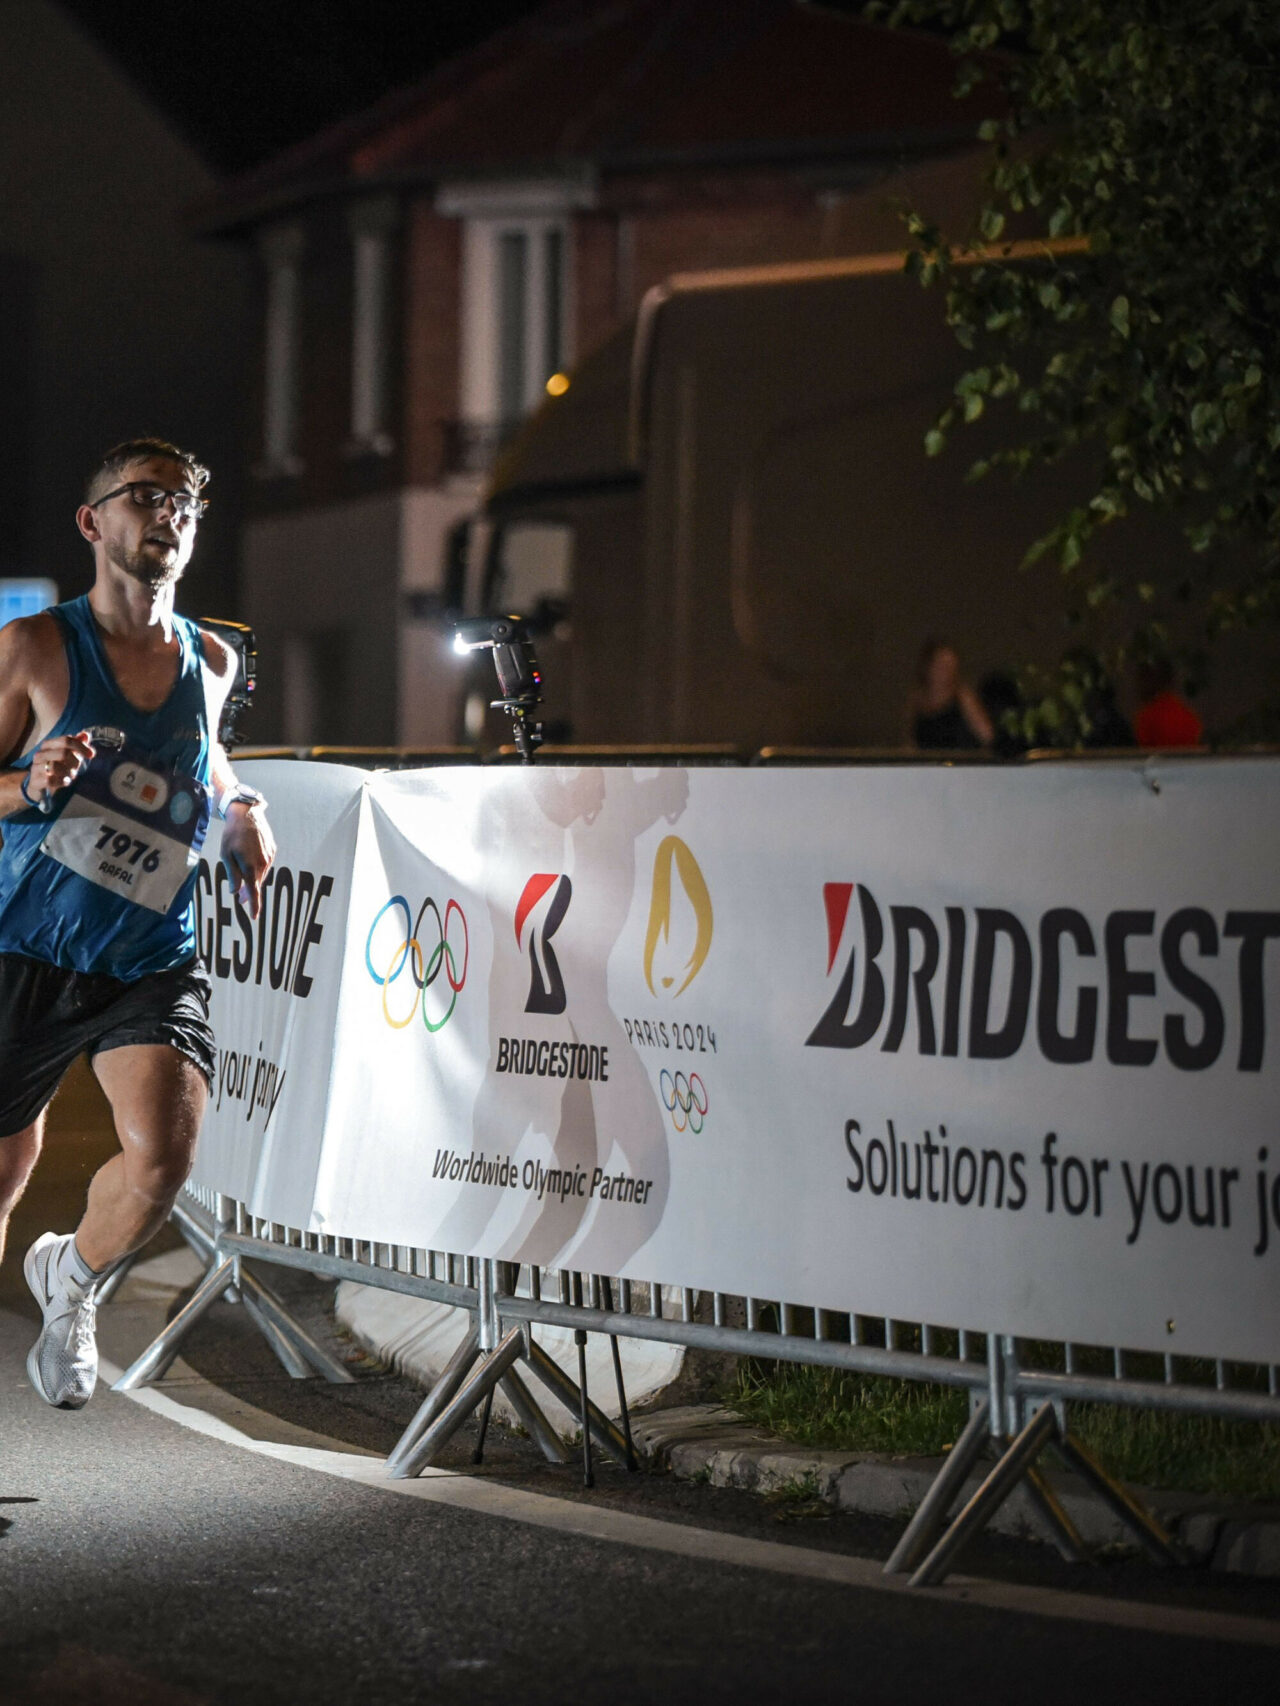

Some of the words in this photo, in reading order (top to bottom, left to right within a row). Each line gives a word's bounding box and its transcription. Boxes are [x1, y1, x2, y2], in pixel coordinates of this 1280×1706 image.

[95, 825, 161, 873] 7976
[98, 861, 133, 885] RAFAL
[496, 1037, 608, 1081] BRIDGESTONE
[672, 1023, 717, 1053] 2024
[432, 1149, 518, 1189] Worldwide
[522, 1160, 586, 1202] Olympic
[590, 1168, 652, 1204] Partner
[844, 1119, 1026, 1211] Solutions
[1041, 1132, 1109, 1217] for
[1122, 1158, 1239, 1245] your
